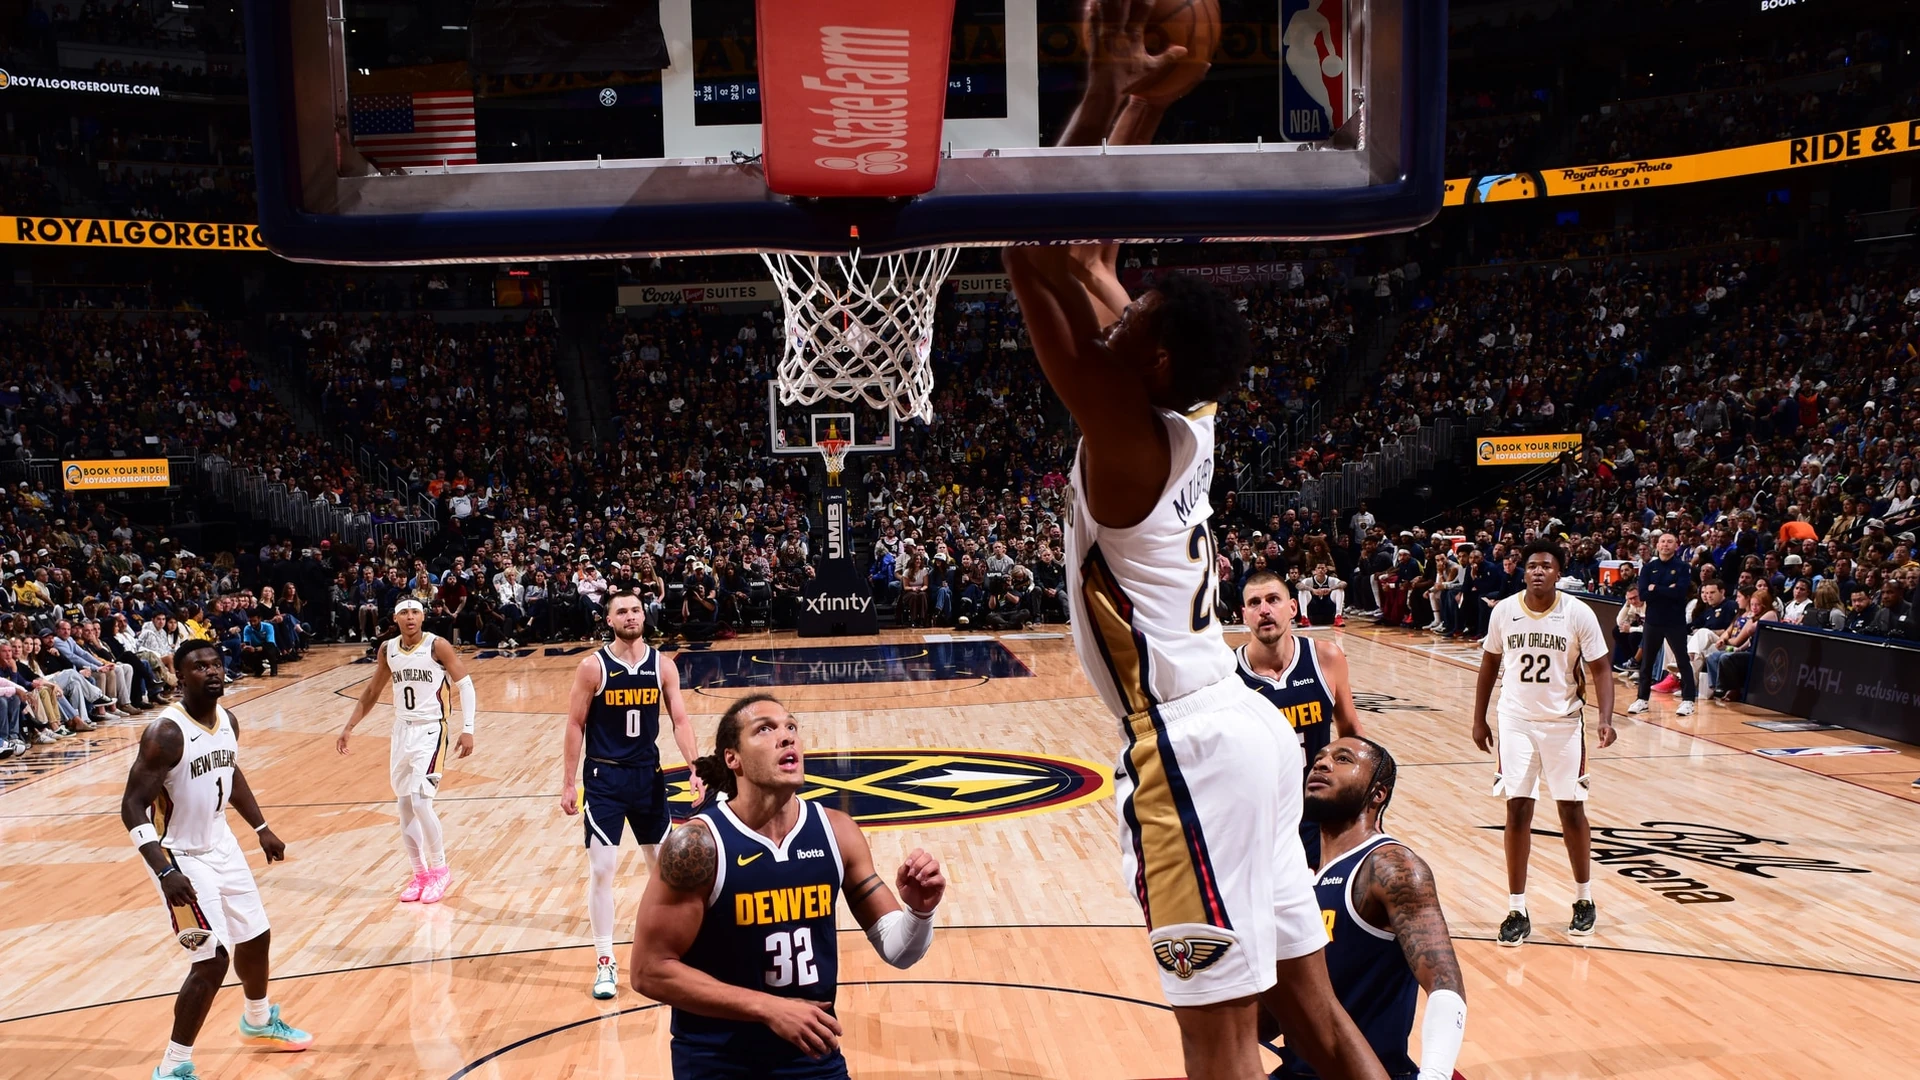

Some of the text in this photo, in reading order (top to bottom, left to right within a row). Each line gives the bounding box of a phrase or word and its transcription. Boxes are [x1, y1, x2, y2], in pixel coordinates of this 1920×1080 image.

[10, 75, 161, 97] ROYALGORGEROUTE.COM
[730, 84, 740, 93] 29
[966, 85, 971, 93] 3
[1290, 109, 1321, 133] NBA
[1790, 130, 1861, 165] RIDE
[1871, 125, 1896, 152] &
[1561, 166, 1601, 182] Royal
[1633, 161, 1673, 173] Route
[1580, 177, 1651, 192] RAILROAD
[642, 287, 682, 302] Coors
[706, 286, 757, 299] SUITES
[1496, 443, 1521, 452] BOOK
[1525, 442, 1550, 451] YOUR
[83, 466, 166, 476] BOOK YOUR RIDE!!
[827, 503, 841, 560] UMB
[806, 592, 872, 614] xfinity
[1507, 632, 1567, 652] NEW ORLEANS
[403, 668, 433, 683] ORLEANS
[1520, 654, 1550, 683] 22
[1292, 677, 1315, 688] ibotta
[1796, 663, 1843, 694] PATH
[1856, 680, 1910, 705] exclusive
[404, 686, 415, 710] 0
[605, 688, 659, 706] DENVER
[625, 708, 641, 738] 0
[190, 753, 211, 780] NEW
[215, 777, 224, 812] 1
[796, 848, 826, 860] ibotta
[1320, 876, 1344, 887] ibotta
[1591, 845, 1736, 905] Arena
[734, 883, 833, 927] DENVER
[764, 926, 820, 988] 32
